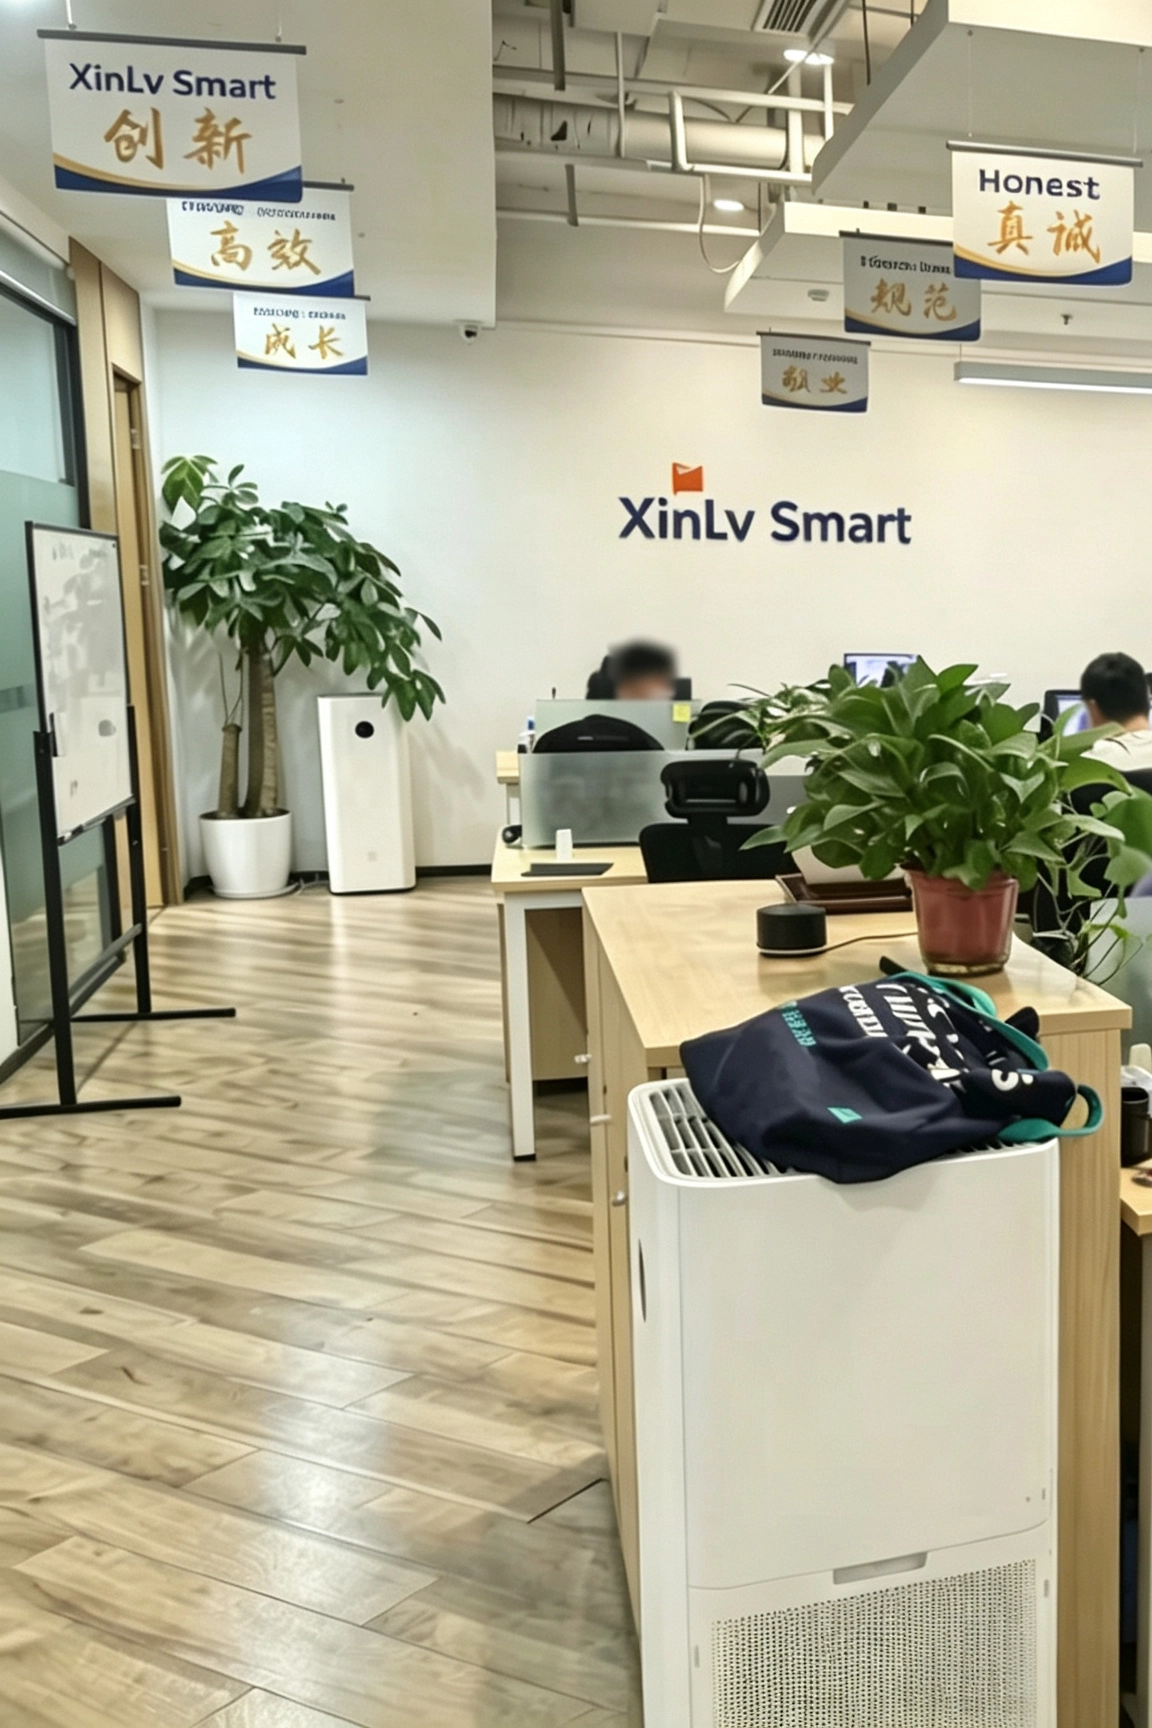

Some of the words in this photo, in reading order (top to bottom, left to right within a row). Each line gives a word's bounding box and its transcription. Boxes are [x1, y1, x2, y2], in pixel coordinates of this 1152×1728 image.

[69, 63, 164, 95] XinLv
[172, 69, 276, 100] Smart
[103, 106, 252, 174] 创新
[978, 168, 1101, 200] Honest
[210, 220, 321, 276] 高效
[987, 200, 1101, 264] 真诚
[264, 323, 343, 359] 成长
[618, 496, 756, 542] XinLv
[770, 500, 912, 544] Smart
